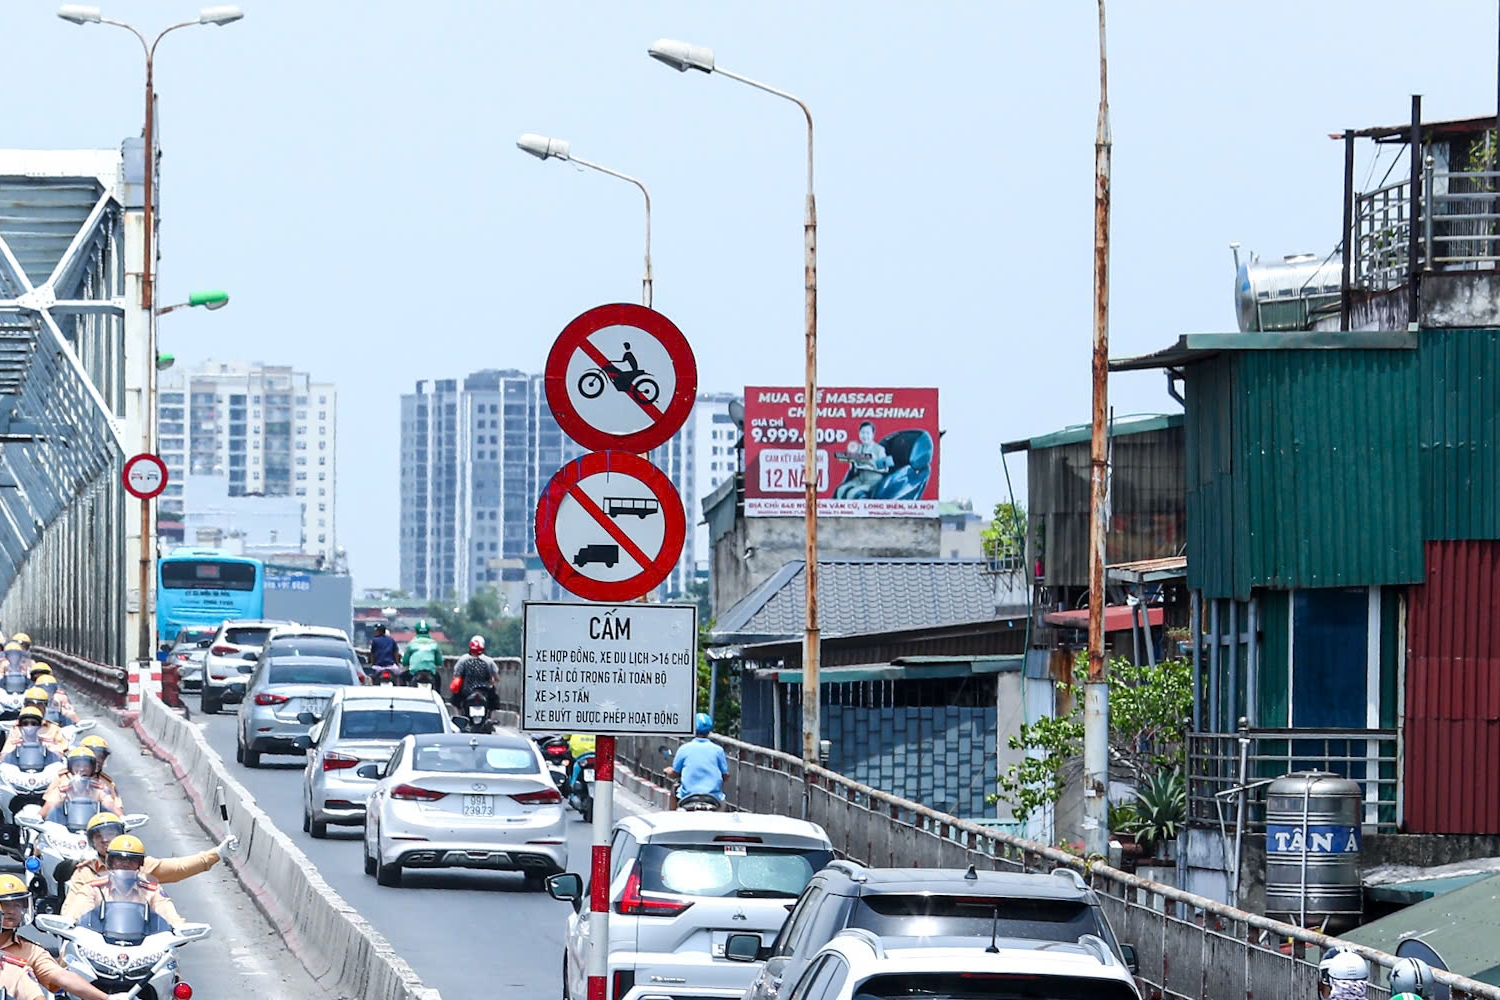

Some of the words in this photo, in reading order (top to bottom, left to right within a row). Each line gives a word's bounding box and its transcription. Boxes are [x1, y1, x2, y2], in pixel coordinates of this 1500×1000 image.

[758, 392, 790, 404] MUA
[794, 389, 825, 404] GẾ
[825, 392, 893, 404] MASSAGE
[816, 407, 847, 418] MUA
[851, 407, 925, 418] WASHIMA!
[751, 428, 848, 443] 9.999.00Đ
[765, 468, 783, 488] 12
[589, 608, 631, 640] CẤM
[535, 650, 547, 662] XE
[550, 650, 568, 665] HỢP
[600, 651, 611, 663] XE
[614, 651, 627, 664] DU
[629, 652, 649, 667] LỊCH
[651, 653, 669, 665] >16
[672, 649, 690, 665] CHỖ
[535, 670, 547, 682] XE
[550, 667, 563, 682] TẢI
[566, 668, 578, 682] CÓ
[581, 670, 610, 685] TRỌNG
[612, 668, 626, 684] TẢI
[629, 669, 652, 684] TOÀN
[655, 670, 667, 687] BỘ
[535, 690, 546, 702] XE
[572, 686, 590, 702] TẤN
[534, 710, 546, 722] XE
[548, 707, 571, 722] BUÝT
[576, 710, 601, 725] ĐƯỢC
[603, 708, 626, 723] PHÉP
[628, 711, 651, 726] HOẠT
[654, 711, 679, 727] ĐỘNG
[1275, 827, 1334, 852] TÂN
[1344, 827, 1359, 852] Á
